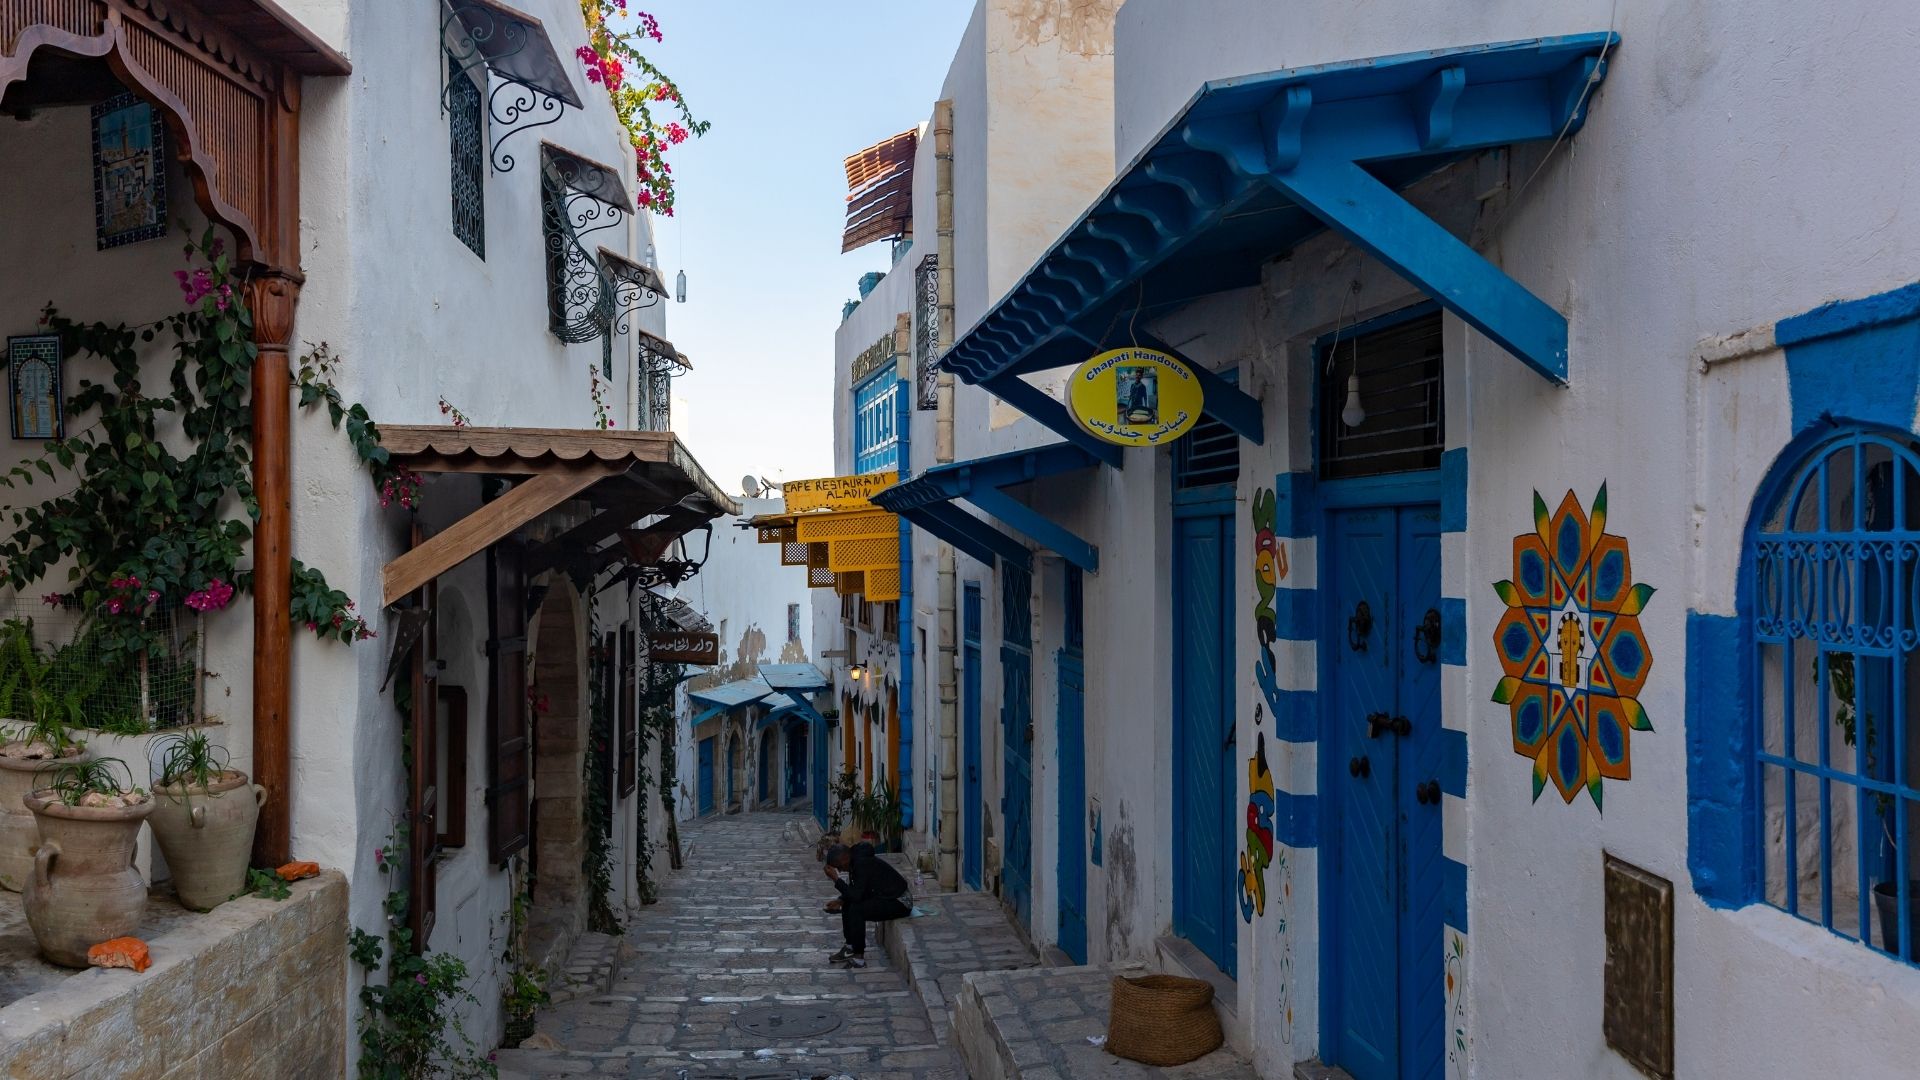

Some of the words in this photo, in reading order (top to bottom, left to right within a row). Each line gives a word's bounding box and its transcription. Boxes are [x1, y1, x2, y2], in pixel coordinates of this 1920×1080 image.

[1086, 352, 1130, 381] Chapati
[1133, 351, 1189, 381] Handouss
[816, 474, 886, 491] RESTAURANT
[827, 487, 871, 500] ALADIN
[690, 637, 714, 653] دار
